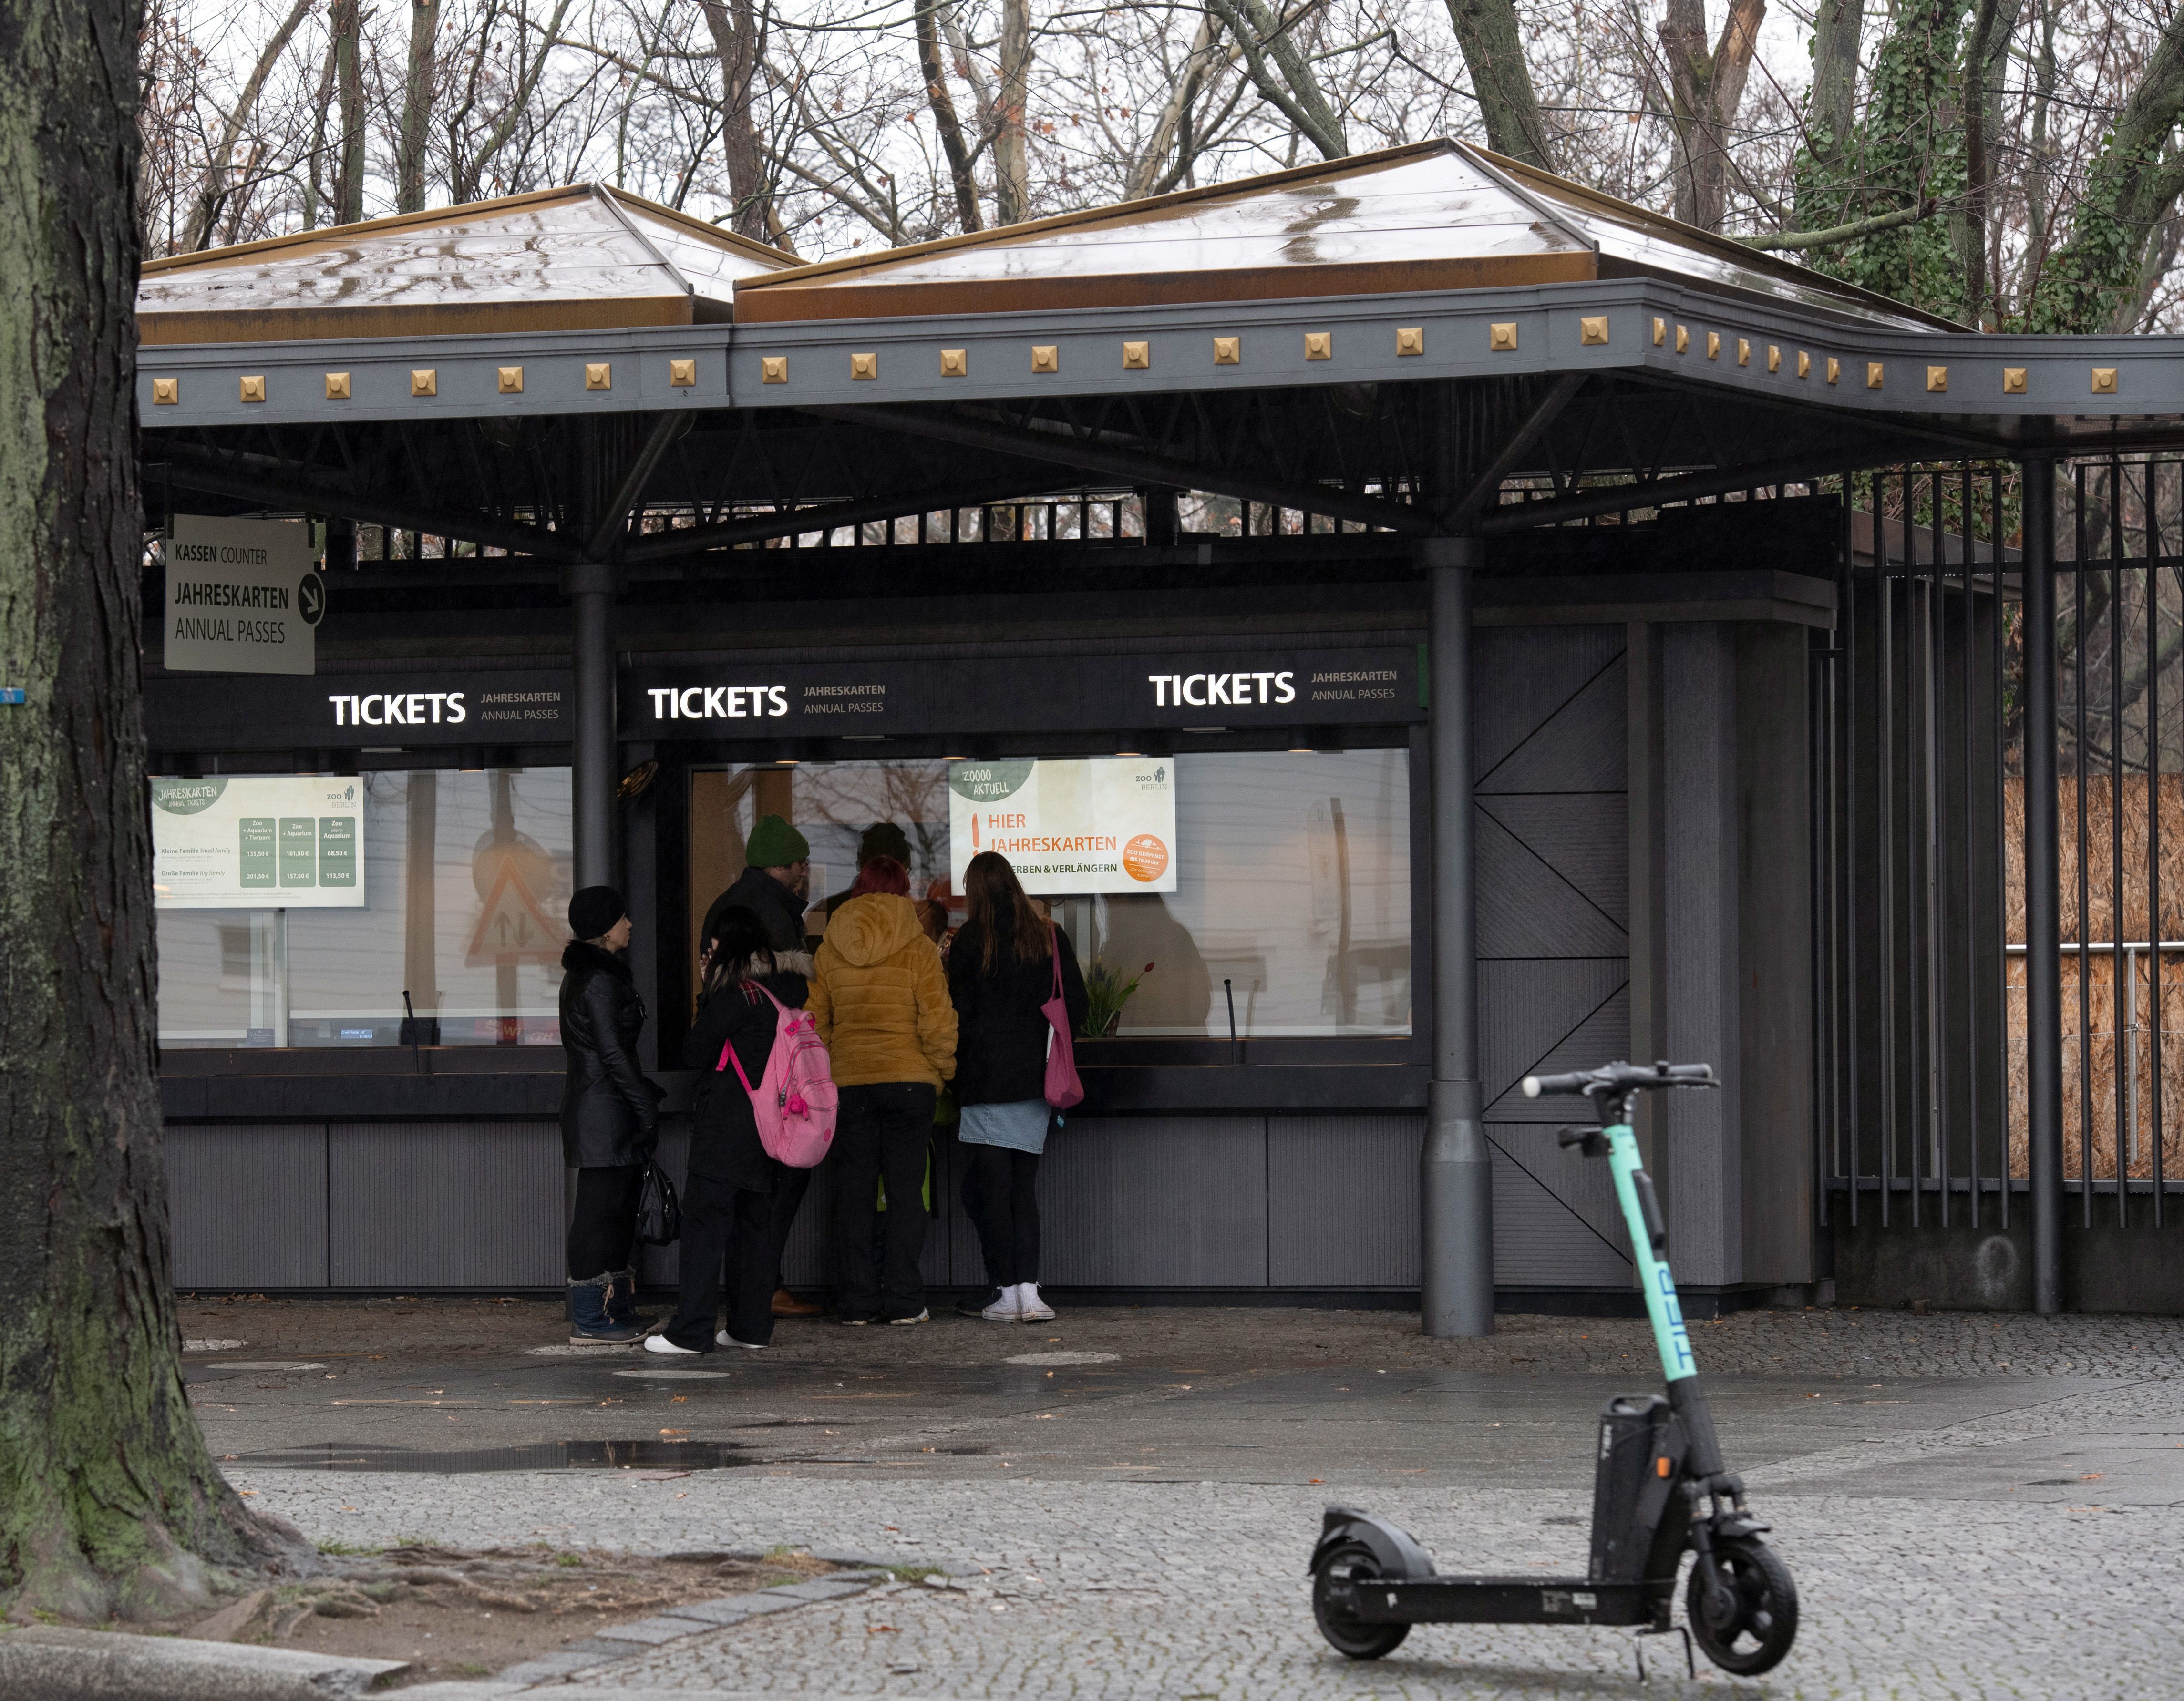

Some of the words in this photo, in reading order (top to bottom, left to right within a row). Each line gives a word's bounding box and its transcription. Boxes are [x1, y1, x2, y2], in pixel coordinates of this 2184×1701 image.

[175, 544, 217, 562] KASSEN
[221, 547, 267, 565] COUNTER
[175, 582, 288, 609] JAHRESKARTEN
[175, 617, 233, 641] ANNUAL
[238, 620, 285, 643] PASSES
[1311, 671, 1397, 683] JAHRESKARTEN
[804, 685, 885, 697] JAHRESKARTEN
[1148, 671, 1295, 706] TICKETS
[1312, 690, 1356, 700] ANNUAL
[1359, 689, 1395, 699] PASSES
[481, 692, 560, 703] JAHRESKARTEN
[647, 685, 788, 719] TICKETS
[329, 692, 466, 725] TICKETS
[481, 710, 522, 720] ANNUAL
[525, 709, 558, 719] PASSES
[804, 703, 845, 714] ANNUAL
[848, 702, 883, 713] PASSES
[962, 769, 991, 782] ZOOOO
[158, 786, 217, 801] JAHRESKARTEN
[973, 782, 1009, 795] AKTUELL
[989, 814, 1026, 828] HIER
[989, 836, 1117, 852] JAHRESKARTEN
[1139, 851, 1164, 860] GEÖFFNET
[1043, 865, 1051, 873] &
[1052, 862, 1117, 873] VERLÄNGERN
